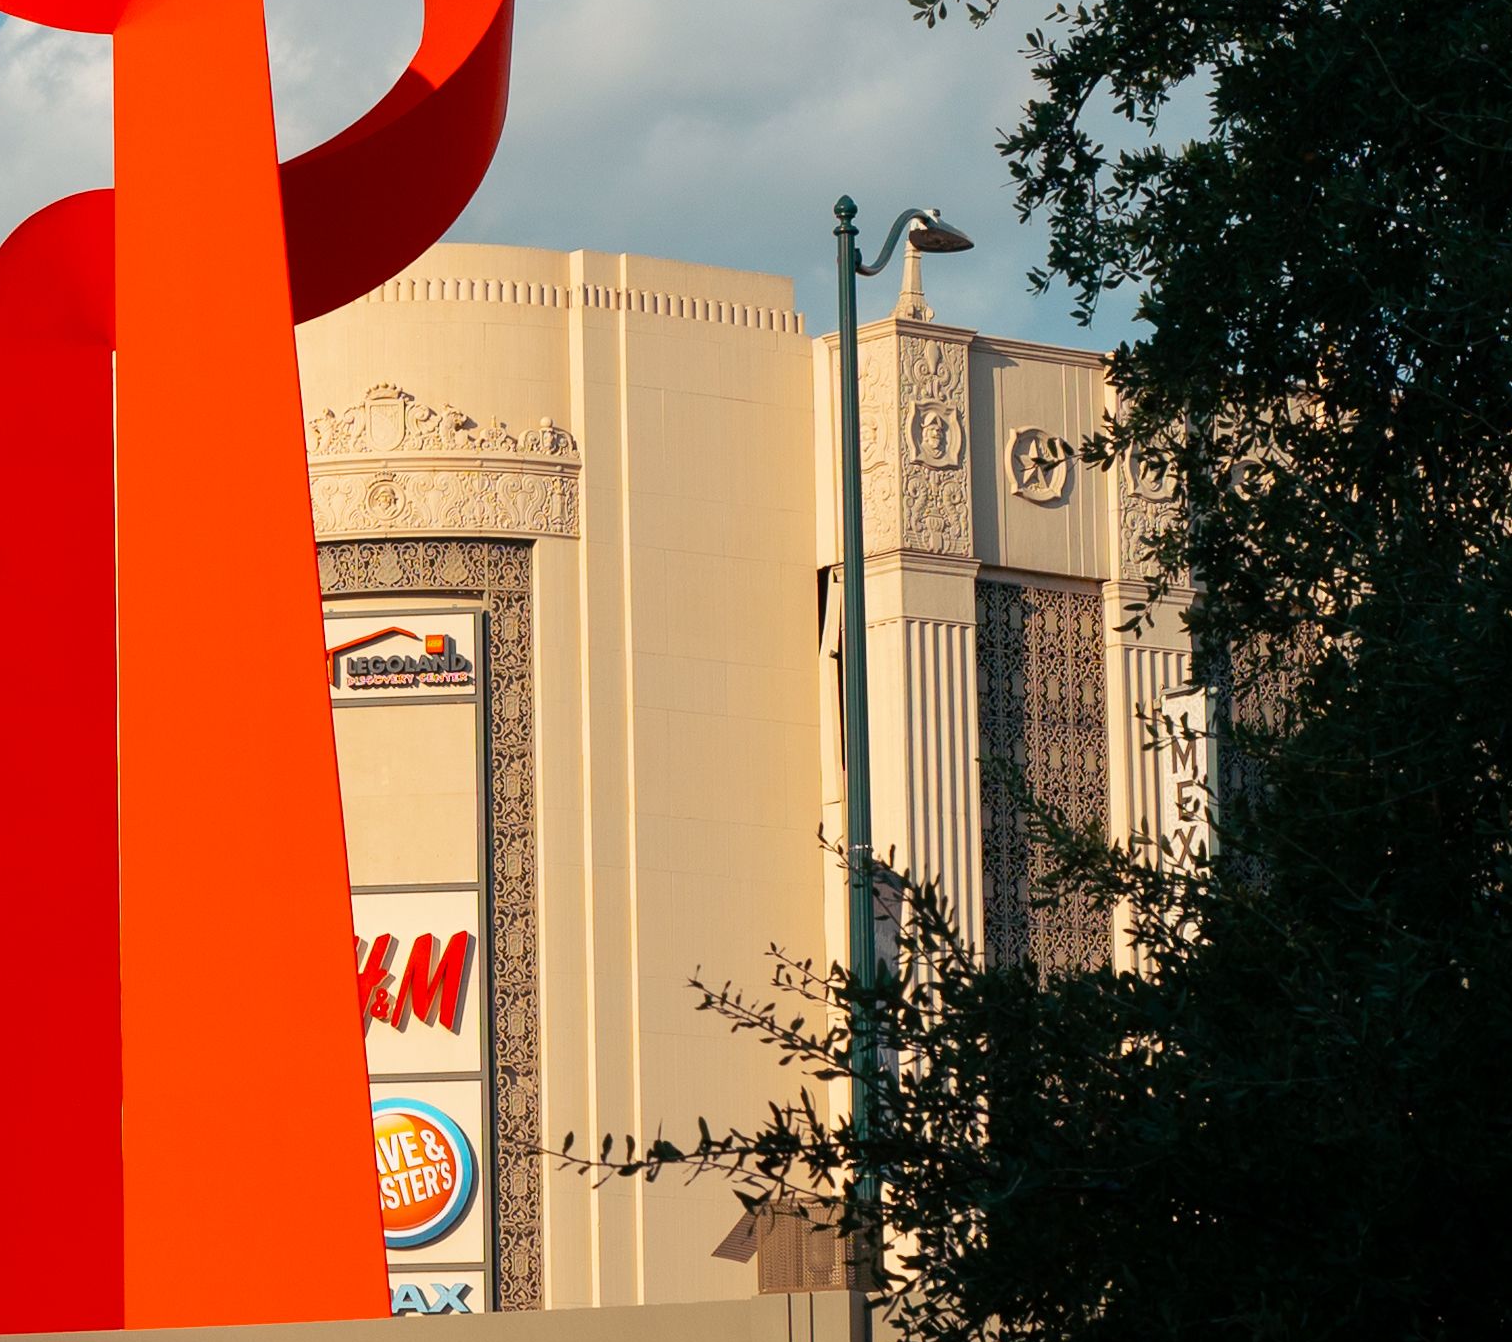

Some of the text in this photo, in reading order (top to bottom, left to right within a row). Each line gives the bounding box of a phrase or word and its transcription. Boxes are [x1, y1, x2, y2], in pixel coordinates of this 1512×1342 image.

[347, 653, 469, 674] LEGOLAND
[347, 671, 469, 686] DISCOVERY CENTER
[420, 1129, 448, 1162] &
[380, 1161, 453, 1211] STER'S
